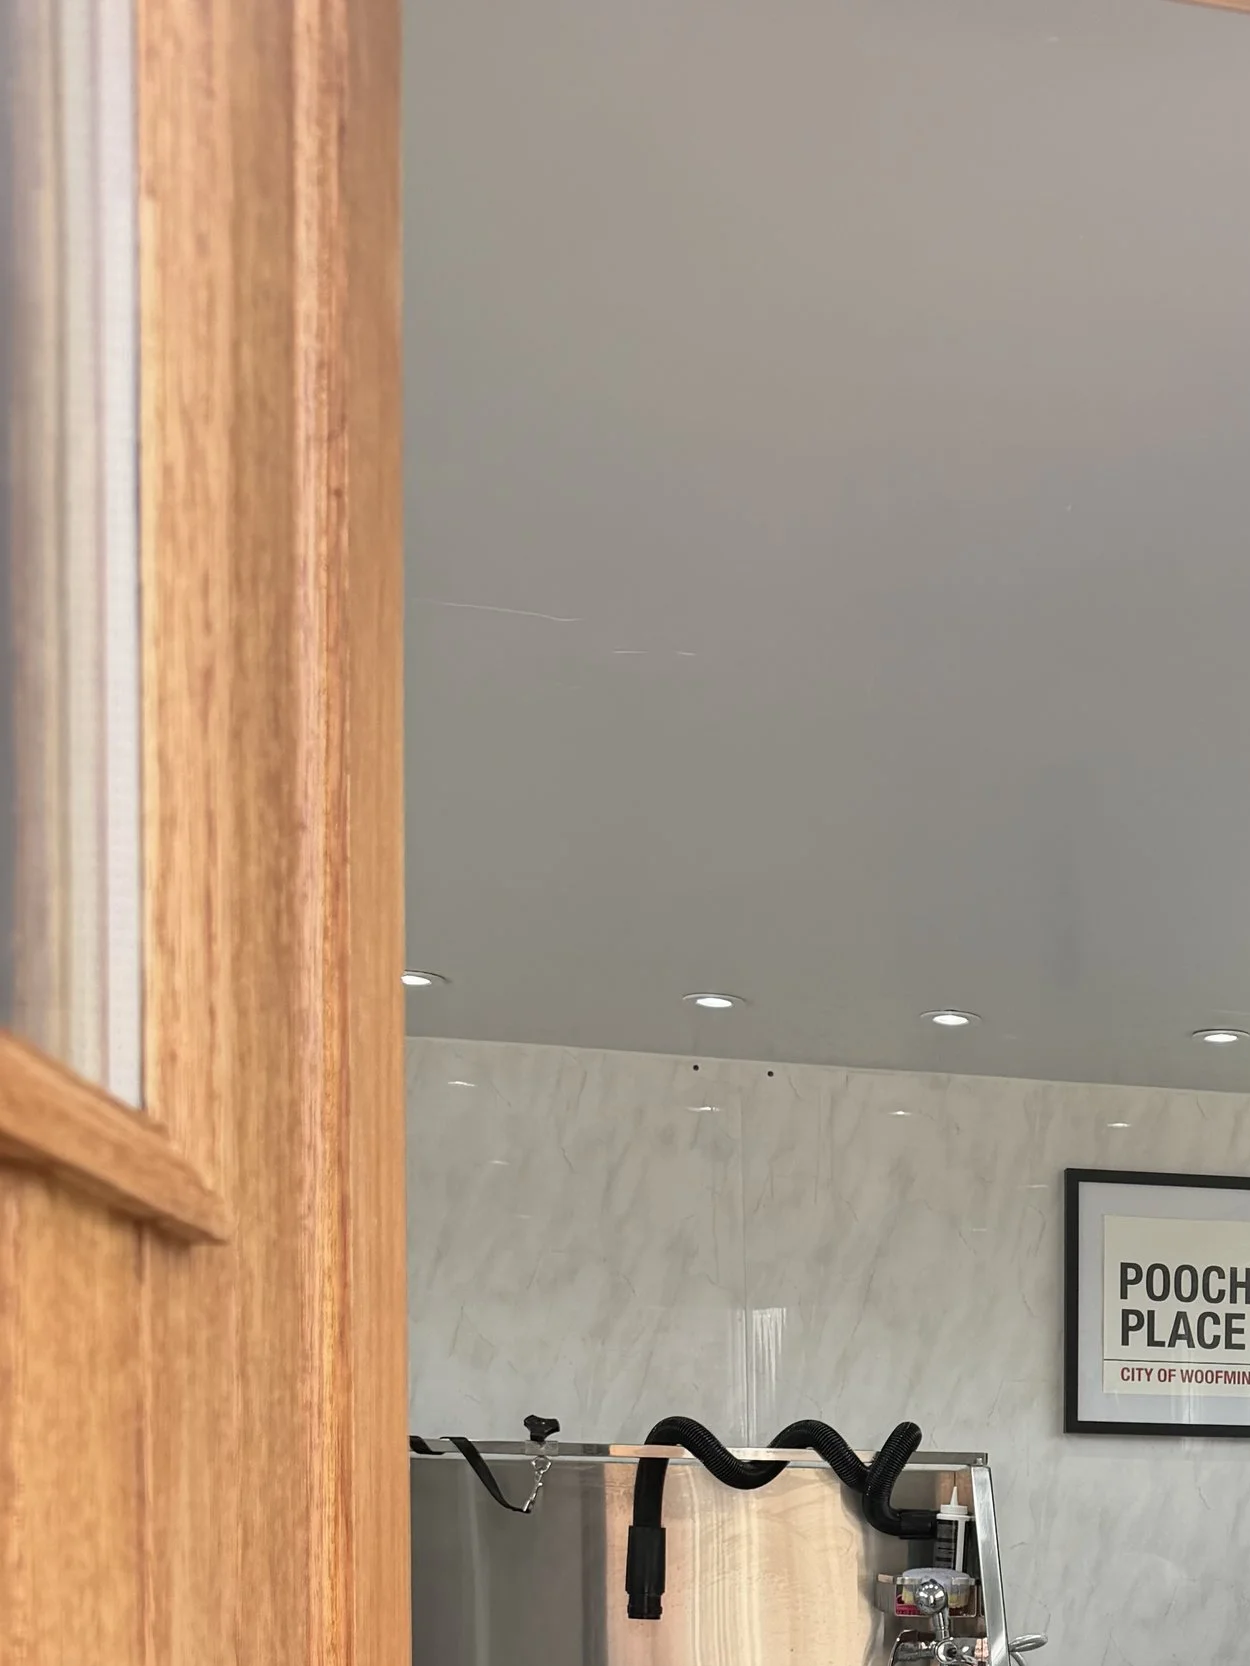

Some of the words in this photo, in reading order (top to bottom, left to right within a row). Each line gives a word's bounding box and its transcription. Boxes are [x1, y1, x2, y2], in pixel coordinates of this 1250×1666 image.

[1120, 1308, 1246, 1350] PLACE
[1120, 1366, 1154, 1382] CITY
[1157, 1368, 1177, 1383] OF
